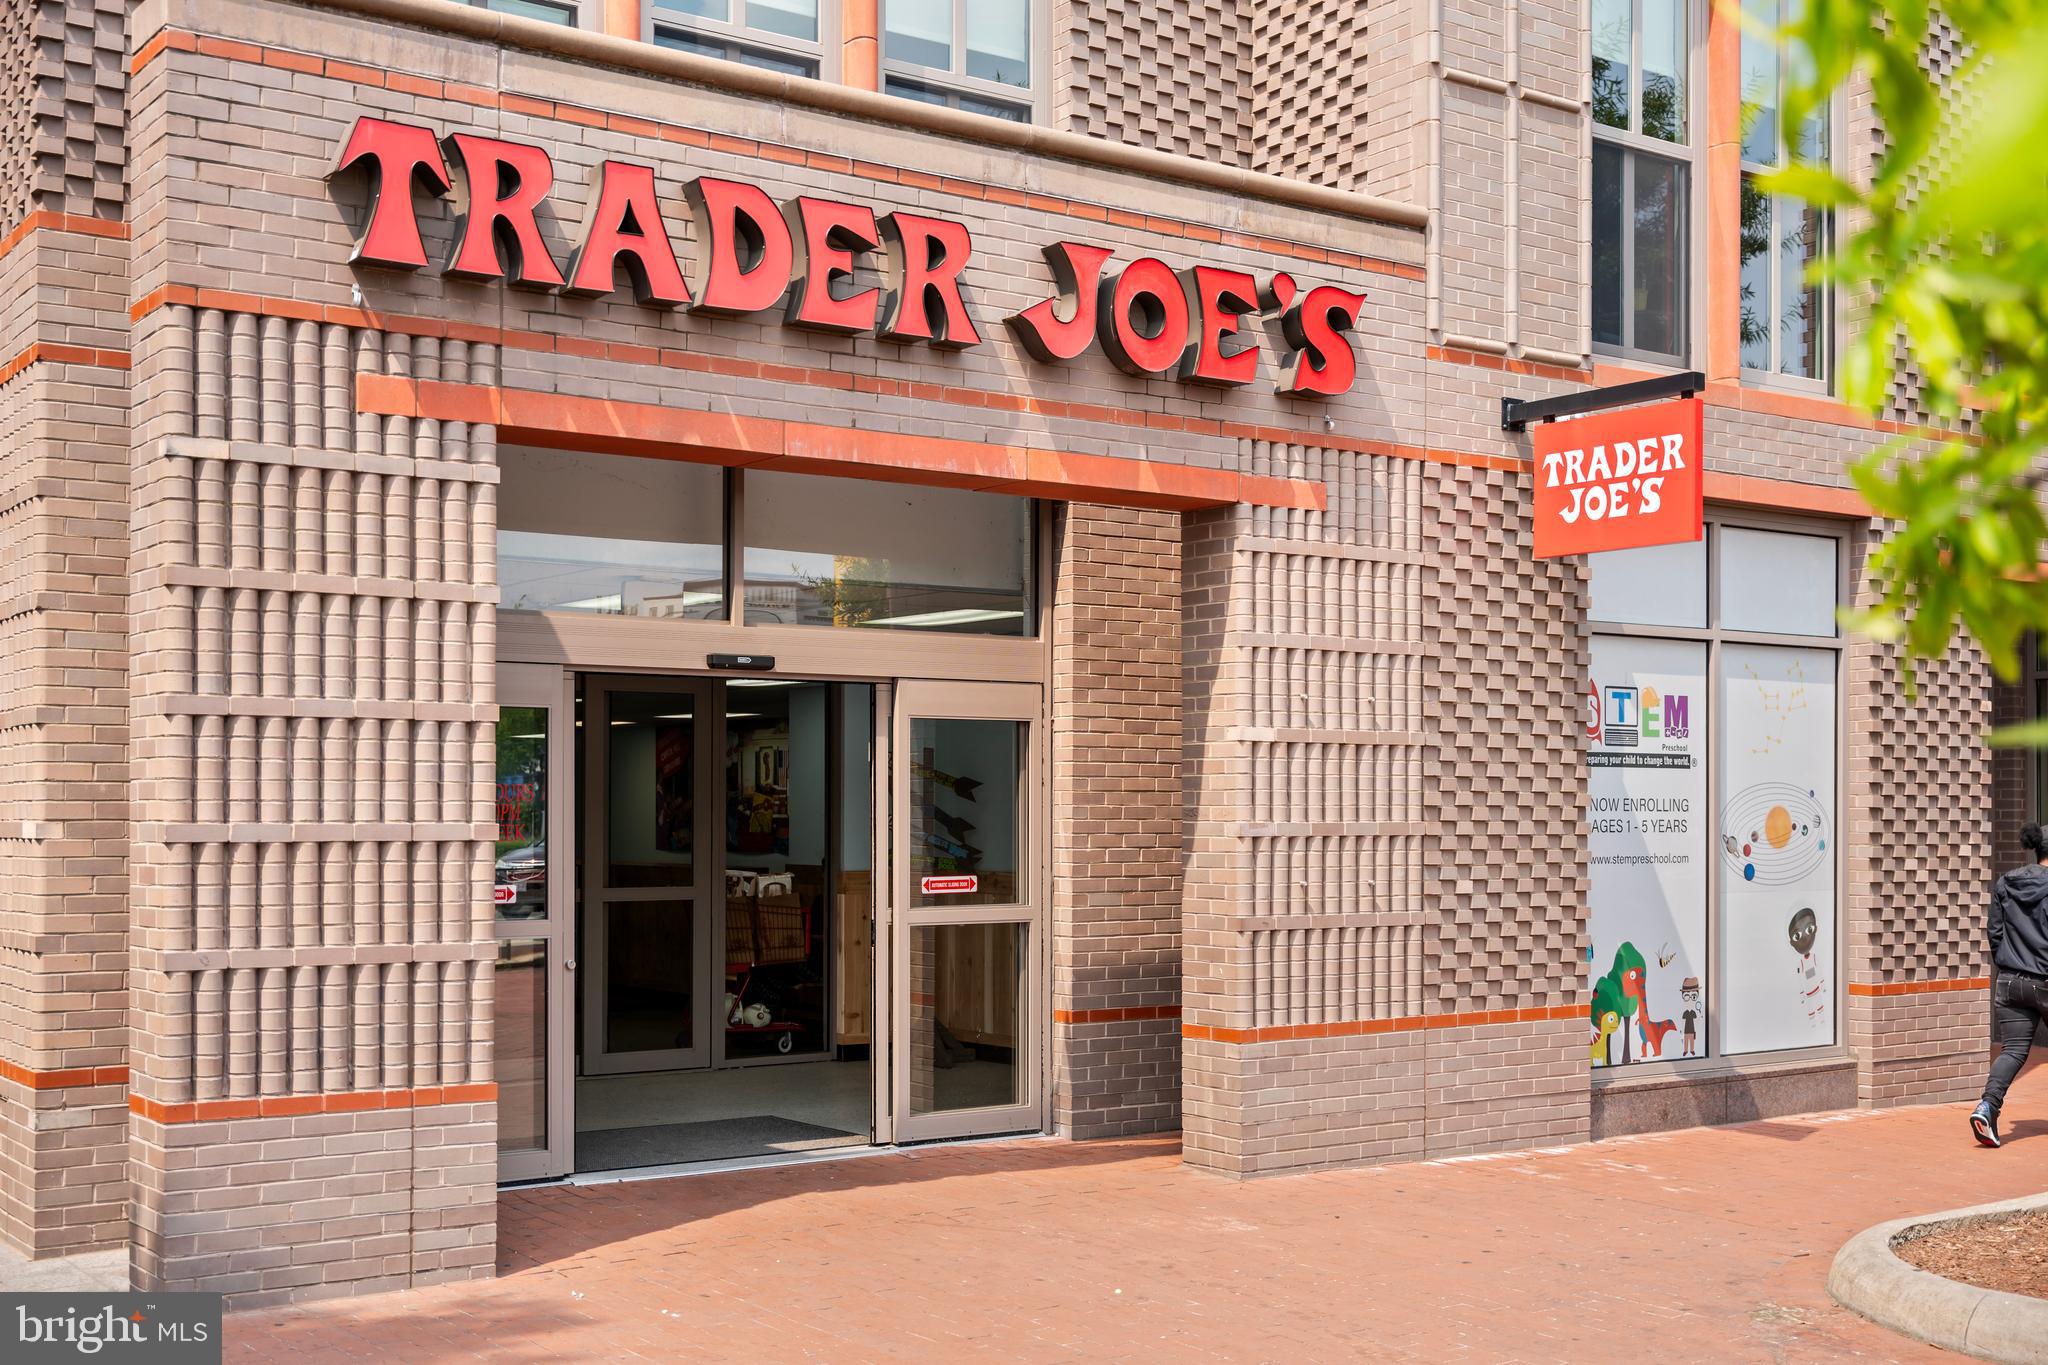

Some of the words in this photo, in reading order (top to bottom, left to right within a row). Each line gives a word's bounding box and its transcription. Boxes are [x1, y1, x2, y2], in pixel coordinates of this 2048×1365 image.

[327, 116, 982, 349] TRADER
[1003, 240, 1367, 397] JOE'S
[1542, 433, 1686, 488] TRADER
[1559, 477, 1665, 524] JOE'S
[1662, 743, 1688, 752] Preschool
[1609, 756, 1622, 766] your
[1622, 754, 1636, 765] child
[1636, 755, 1643, 765] to
[1643, 755, 1663, 767] change
[1663, 755, 1673, 766] the
[1590, 798, 1620, 812] NOW
[1623, 798, 1689, 812] ENROLLING
[1592, 819, 1624, 833] AGES
[1626, 819, 1631, 833] 1
[1641, 819, 1648, 833] 5
[1651, 819, 1688, 833] YEARS
[1590, 852, 1689, 867] www.stempreschool.com
